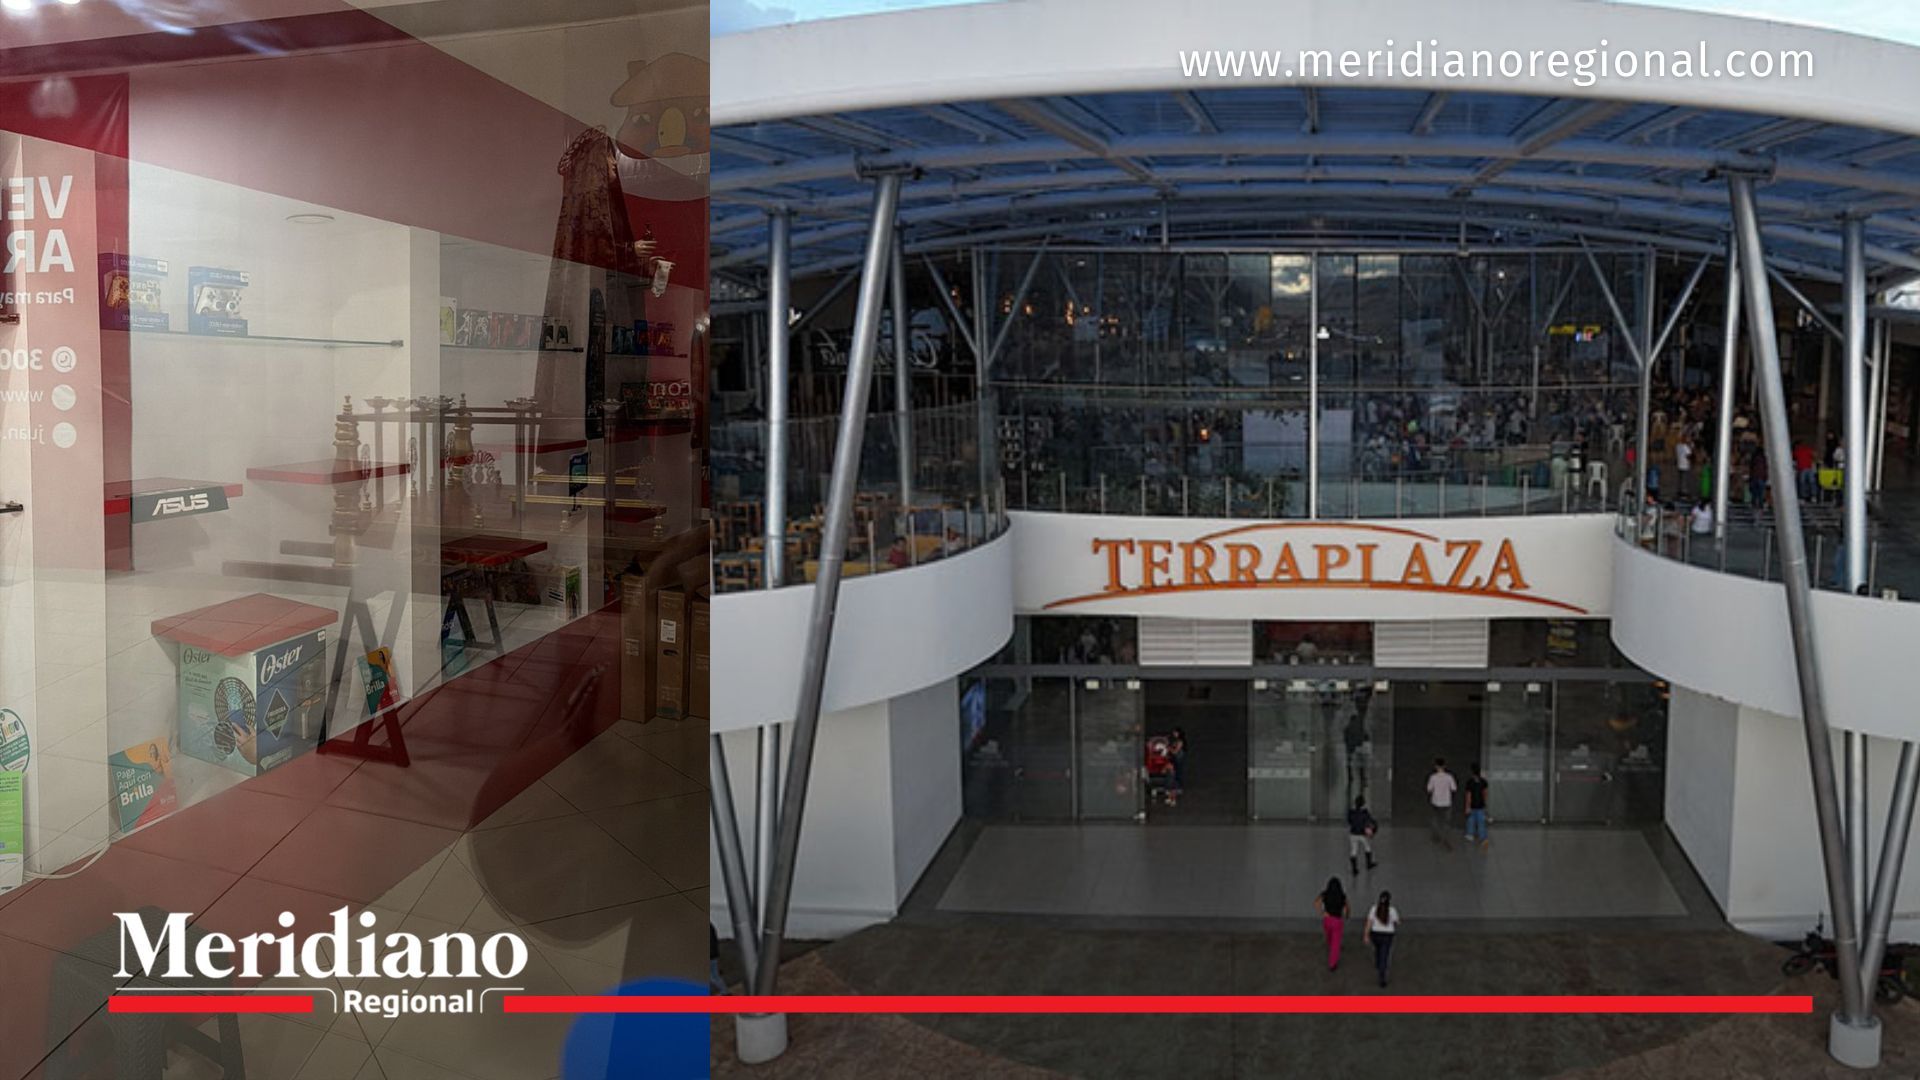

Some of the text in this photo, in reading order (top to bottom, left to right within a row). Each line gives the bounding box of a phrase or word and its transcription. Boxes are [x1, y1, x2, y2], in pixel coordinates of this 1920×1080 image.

[152, 493, 209, 516] ASUS
[1093, 538, 1529, 592] TERRAPLAZA
[183, 647, 211, 665] Oster
[261, 645, 303, 685] Oster
[116, 768, 135, 781] Paga
[137, 771, 152, 783] con
[120, 783, 154, 806] Brilla
